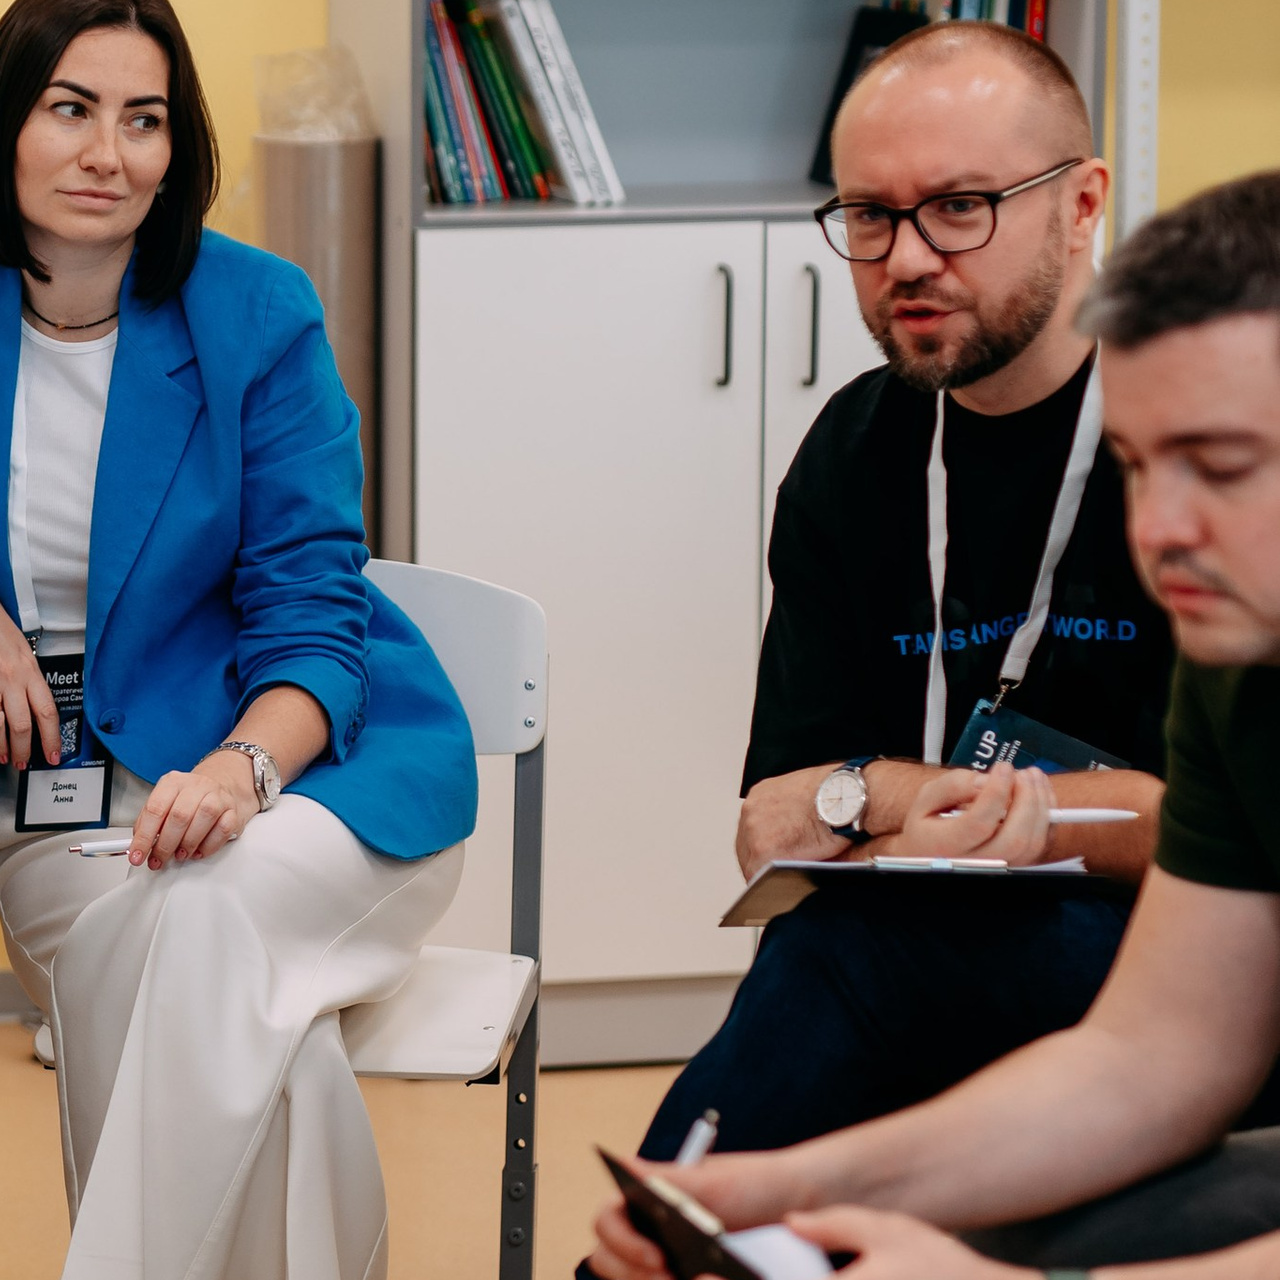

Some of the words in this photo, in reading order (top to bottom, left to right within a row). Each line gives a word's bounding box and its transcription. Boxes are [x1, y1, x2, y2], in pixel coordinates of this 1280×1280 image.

[1051, 615, 1137, 641] WORD
[46, 671, 79, 684] Meet
[51, 781, 78, 792] Донец
[53, 794, 74, 803] Анна
